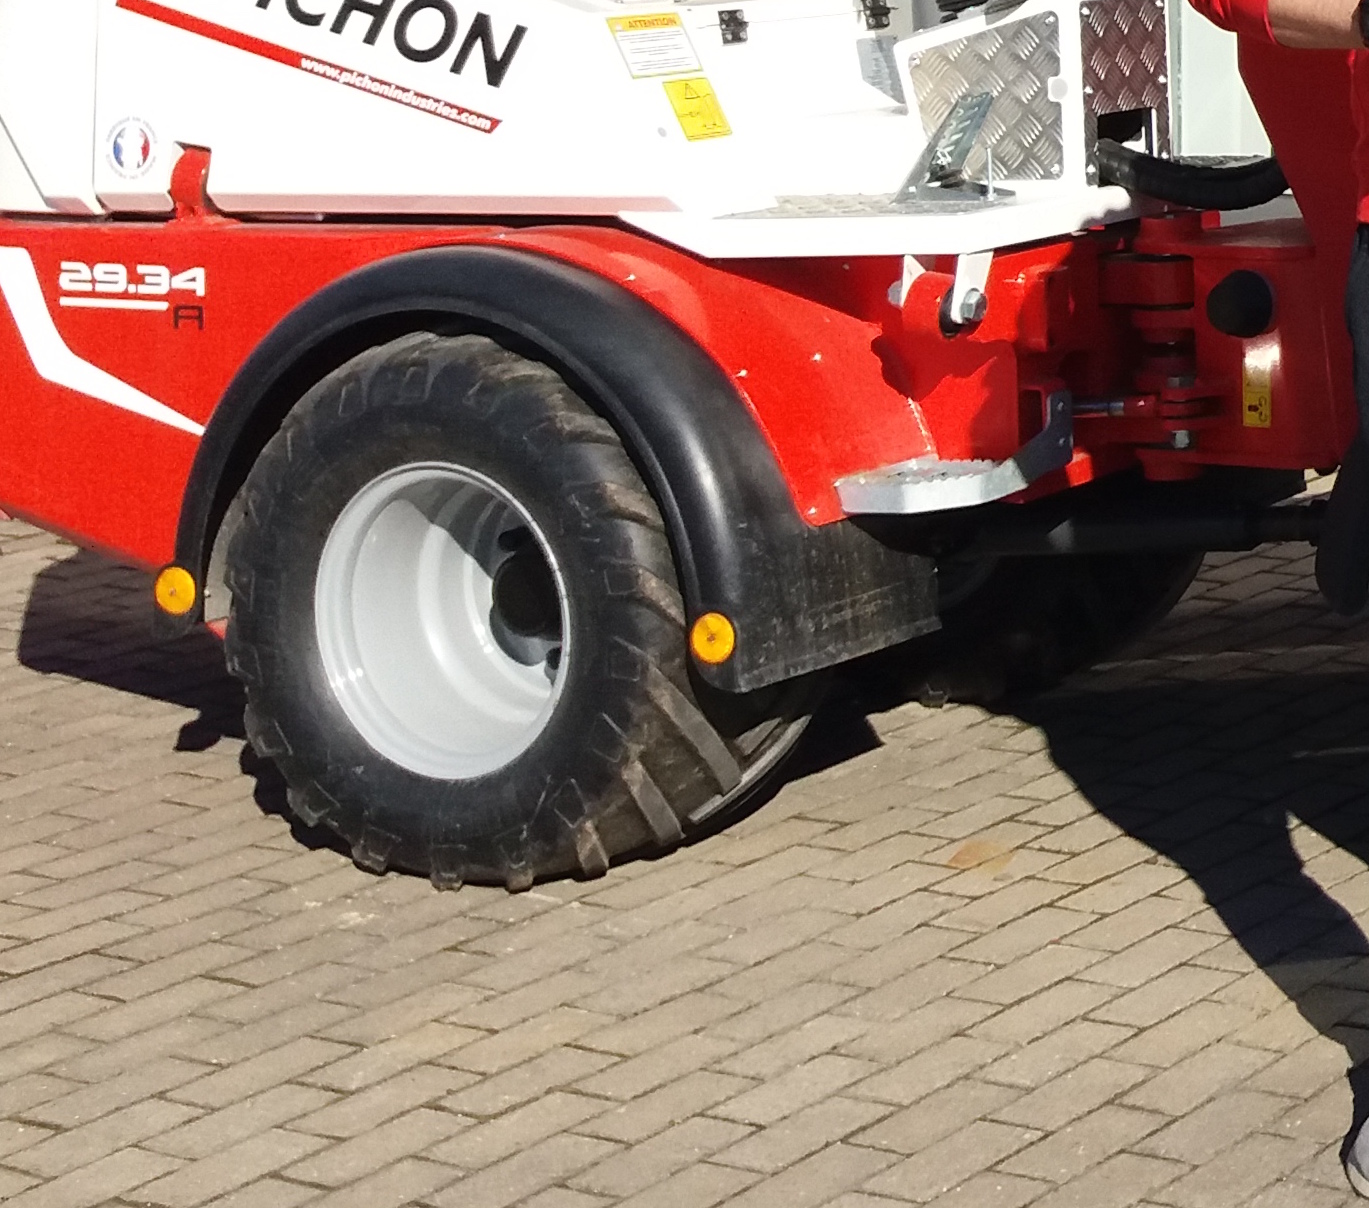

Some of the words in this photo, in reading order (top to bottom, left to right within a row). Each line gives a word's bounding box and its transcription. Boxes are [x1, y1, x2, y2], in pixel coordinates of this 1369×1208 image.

[628, 17, 677, 29] ATTENTION
[300, 56, 492, 131] www.pichonindustries.com
[58, 260, 206, 297] 29.34
[172, 305, 205, 330] A
